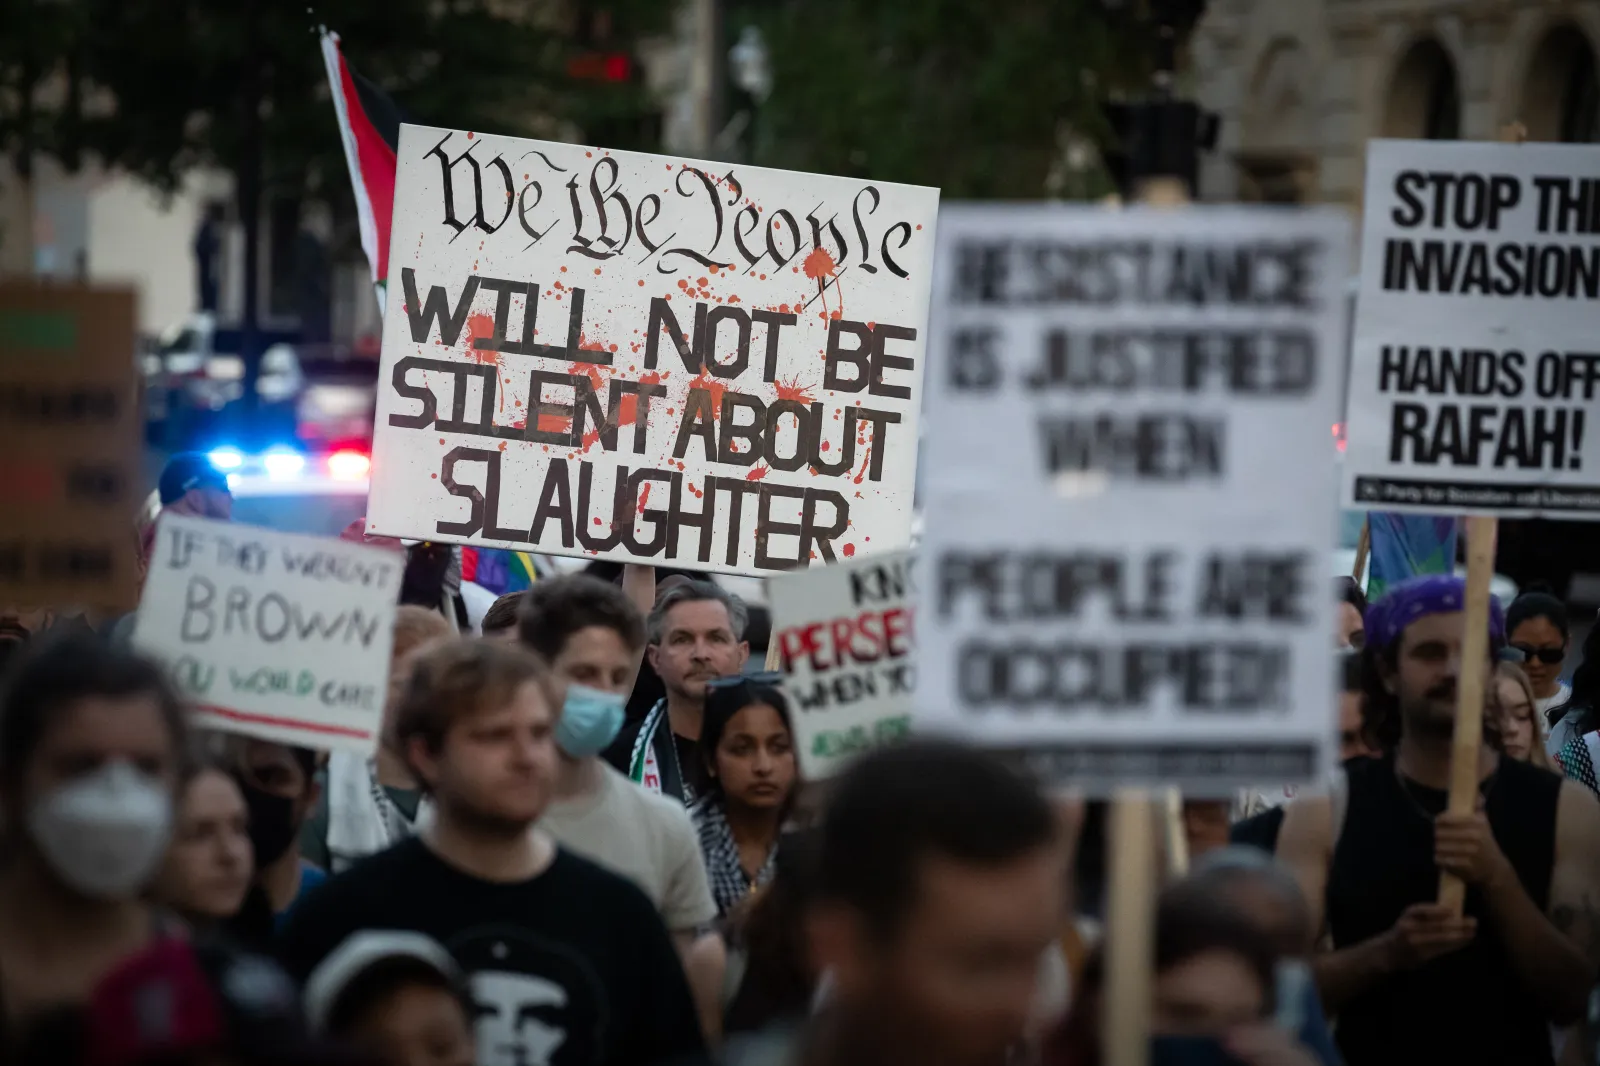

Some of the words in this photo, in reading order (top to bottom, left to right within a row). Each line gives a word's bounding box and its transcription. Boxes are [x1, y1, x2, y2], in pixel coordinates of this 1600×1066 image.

[422, 132, 567, 244] We
[566, 157, 676, 258] the
[657, 167, 912, 310] People
[1390, 169, 1522, 231] STOP
[1532, 175, 1600, 234] TH
[950, 238, 1318, 310] RESISTANCE
[401, 267, 613, 366] WILL
[644, 297, 797, 383] NOT
[823, 319, 917, 400] BE
[947, 325, 999, 392] IS
[1022, 326, 1317, 394] JUSTIFIED
[1377, 344, 1526, 399] HANDS
[389, 356, 666, 454] SILENT
[673, 388, 902, 482] ABOUT
[1037, 412, 1228, 480] WHEN
[1388, 402, 1586, 472] RAFAH!
[437, 447, 850, 570] SLAUGHTER
[167, 527, 204, 570] IF
[180, 574, 380, 648] BROWN
[936, 549, 1177, 623] PEOPLE
[1200, 550, 1315, 625] ARE
[173, 655, 216, 693] OU
[778, 606, 917, 676] PERSE
